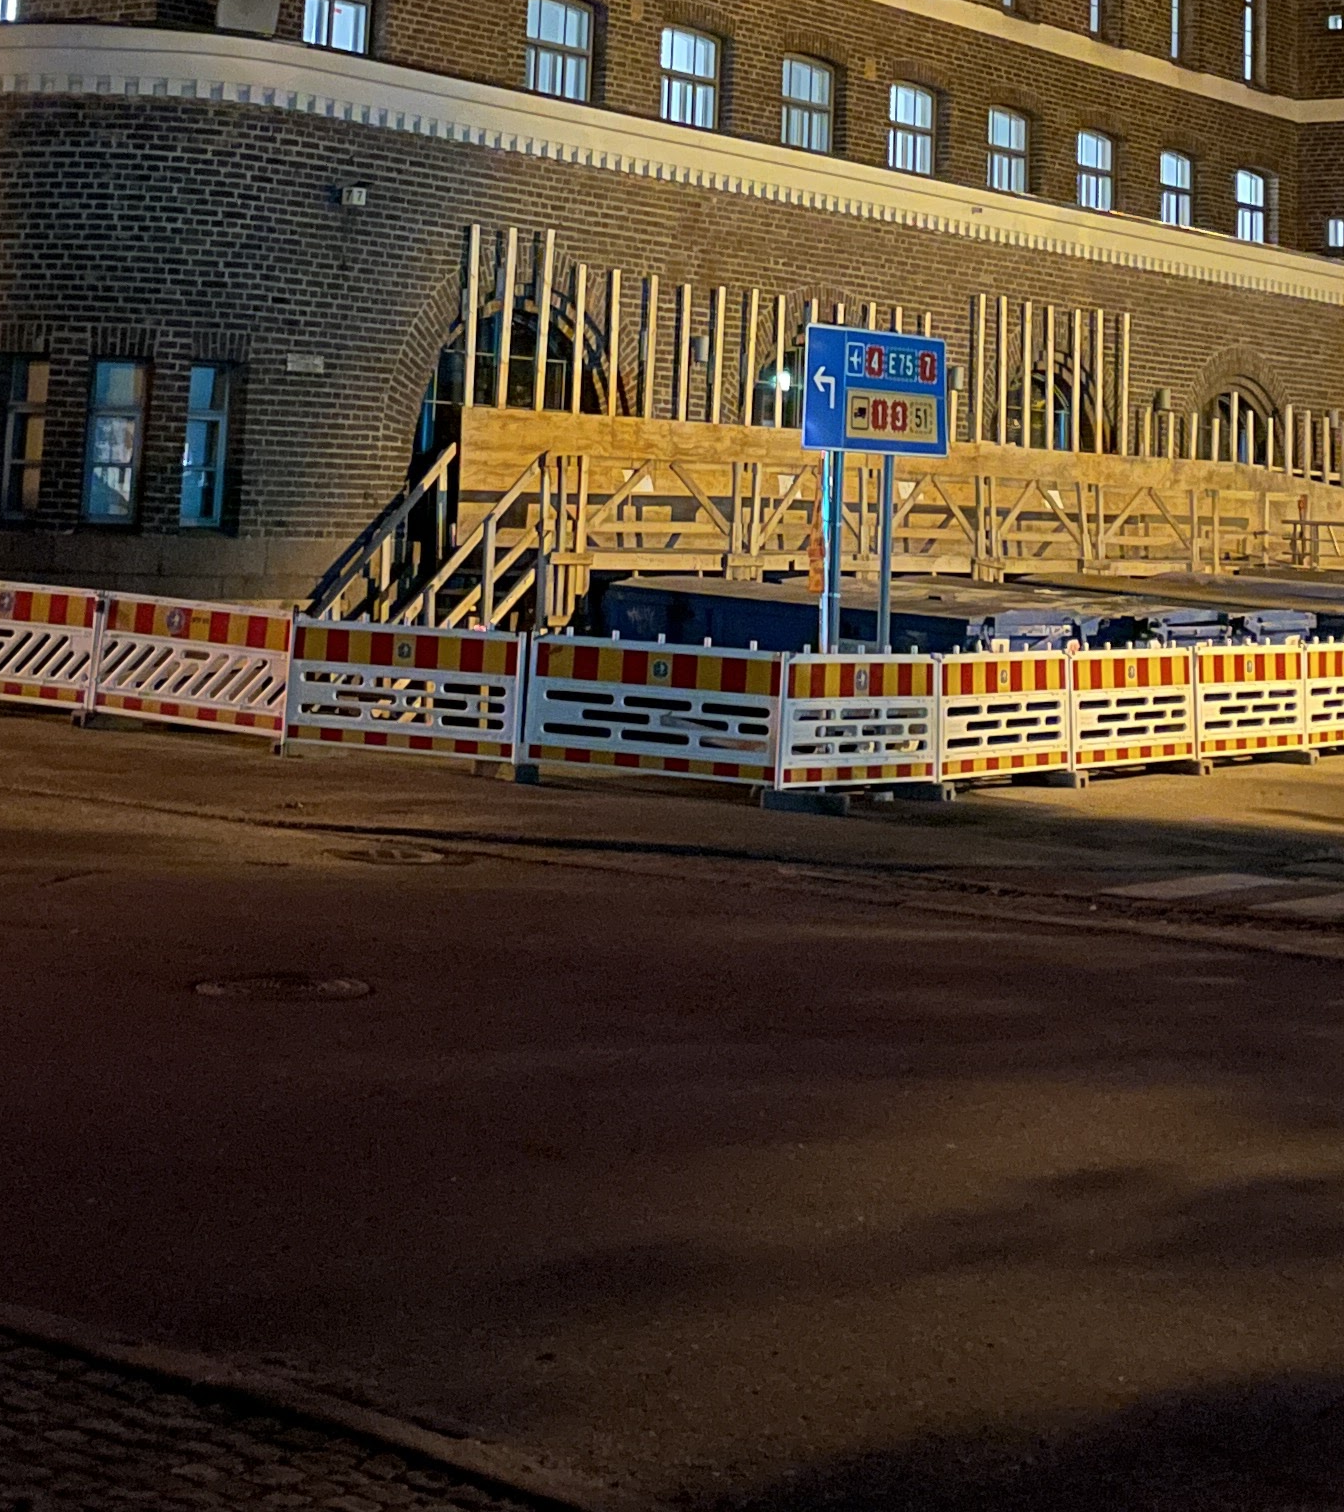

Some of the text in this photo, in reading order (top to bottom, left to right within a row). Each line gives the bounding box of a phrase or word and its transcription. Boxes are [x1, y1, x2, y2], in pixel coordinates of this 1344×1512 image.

[871, 351, 879, 372] 4
[924, 356, 932, 377] 7
[877, 404, 929, 429] 1 3 51
